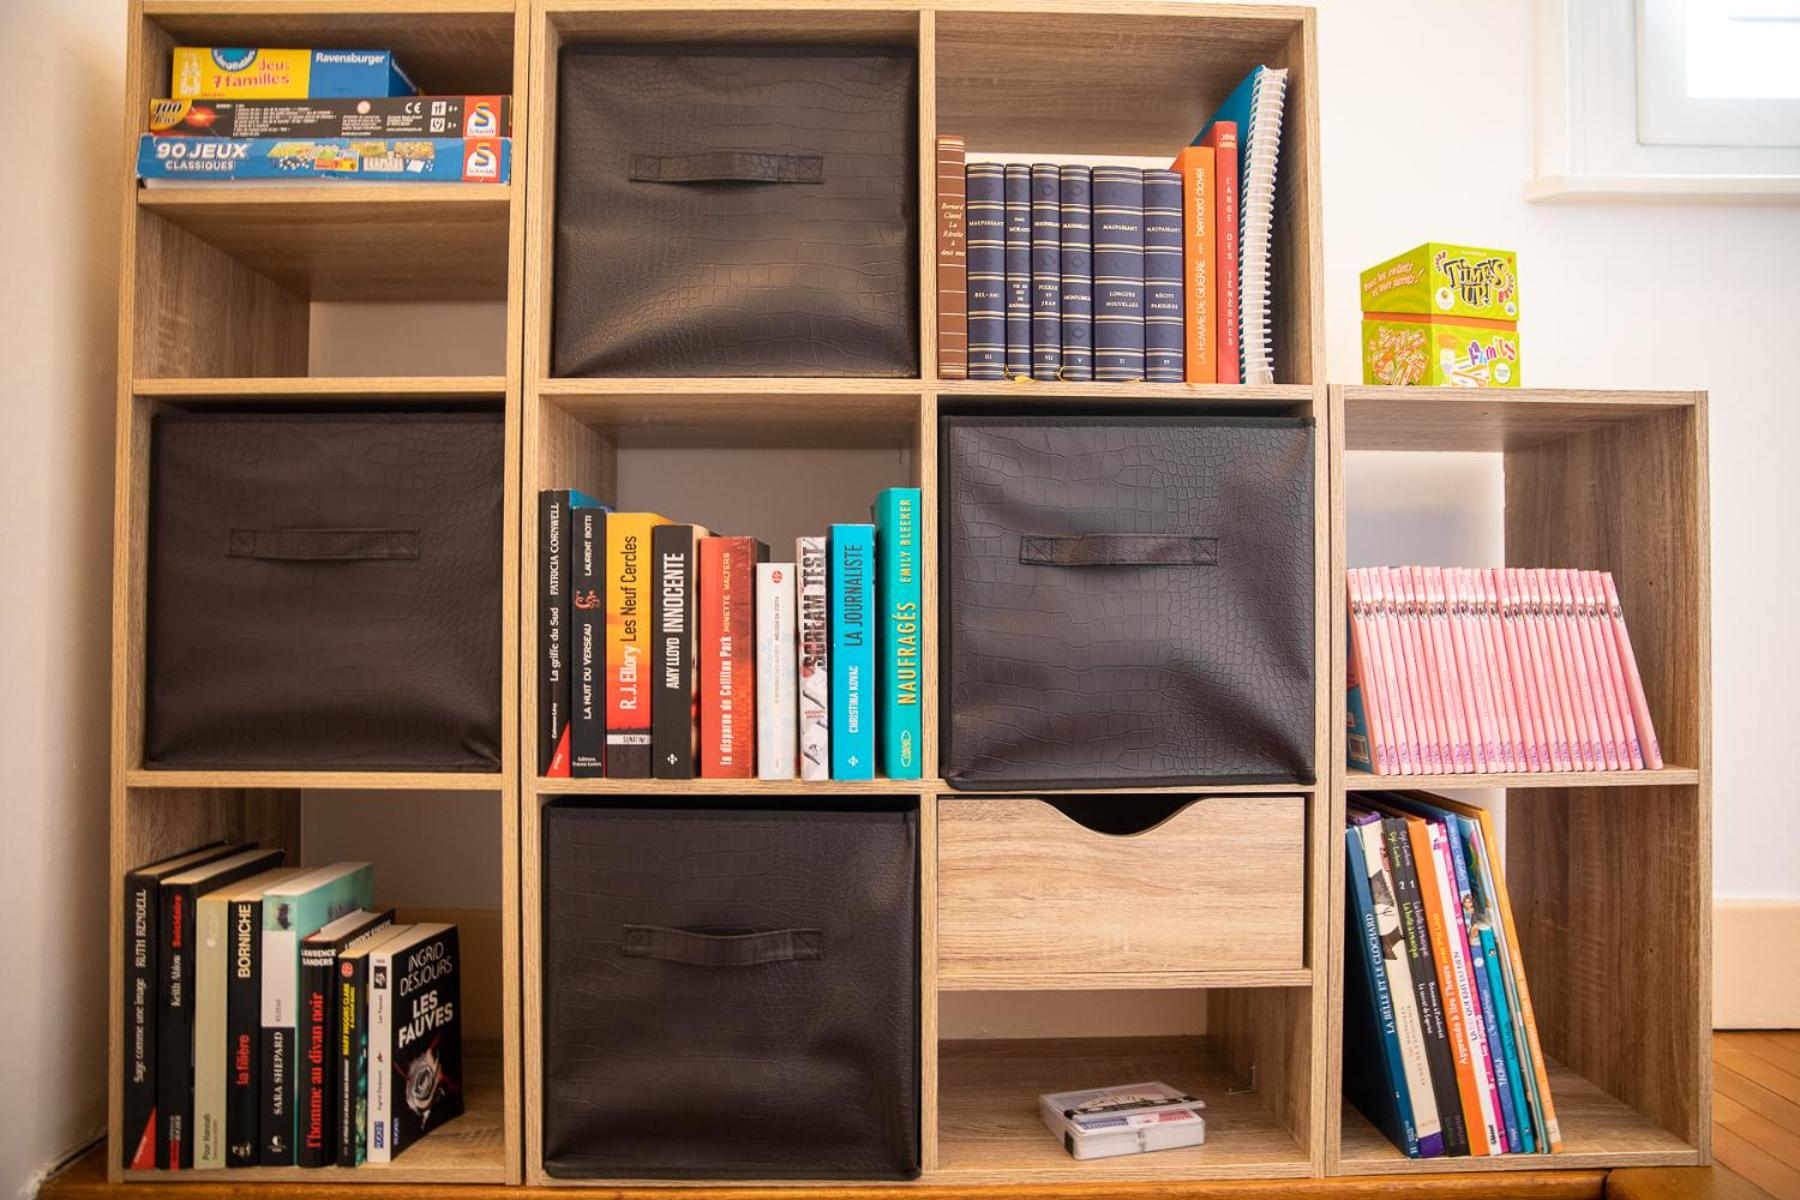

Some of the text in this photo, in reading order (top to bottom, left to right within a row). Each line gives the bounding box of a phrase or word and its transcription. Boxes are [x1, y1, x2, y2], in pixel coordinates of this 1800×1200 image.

[214, 74, 290, 88] 7 familles
[316, 53, 385, 65] Ravensburger
[157, 143, 248, 159] 90 JEUX
[165, 161, 234, 171] CLASSIQUES
[1192, 168, 1205, 236] bernard clavel
[1195, 260, 1206, 298] GUERRE
[1195, 315, 1206, 351] FEMME
[549, 502, 560, 595] PATRICIA CORNWELL
[584, 515, 592, 576] LAURENT BOTTI
[899, 499, 912, 584] EMILY BLEEKER
[619, 536, 638, 642] Les Neuf Cercles
[663, 553, 684, 633] INNOCENTE
[722, 552, 731, 632] MINETTE WALTERS
[802, 546, 826, 668] SCREAM TEST
[844, 544, 863, 647] LA JOURNALISTE
[549, 607, 561, 682] La griffe du Sud
[584, 624, 592, 719] LA NUIT DU VERSEAU
[620, 645, 640, 682] Ellory
[666, 638, 680, 689] AMY LLOYD
[892, 602, 916, 705] NAUFRAGÉS
[719, 637, 736, 765] la disparue de Colliton Park
[848, 665, 859, 733] CHRISTINA KOVAC
[1398, 880, 1406, 890] 2
[1409, 879, 1415, 888] 1
[135, 889, 147, 968] RUTH RENDELL
[172, 894, 182, 948] Suicidaire
[238, 904, 252, 978] BORNICHE
[400, 958, 452, 996] DESJOURS
[409, 942, 444, 972] INGRID
[1365, 913, 1395, 1034] LA BELLE ET LE CLOCHARD
[1442, 965, 1454, 996] l'heure
[170, 982, 182, 1007] Keith
[413, 990, 438, 1019] LES
[1446, 996, 1458, 1013] lire
[133, 978, 146, 1083] Sage comme une image
[399, 1002, 453, 1048] FAUVES
[1452, 1022, 1469, 1065] Apprends
[236, 1034, 250, 1085] la filière
[273, 1031, 283, 1115] SARA SHEPARD
[306, 992, 324, 1148] l'homme au divan noir
